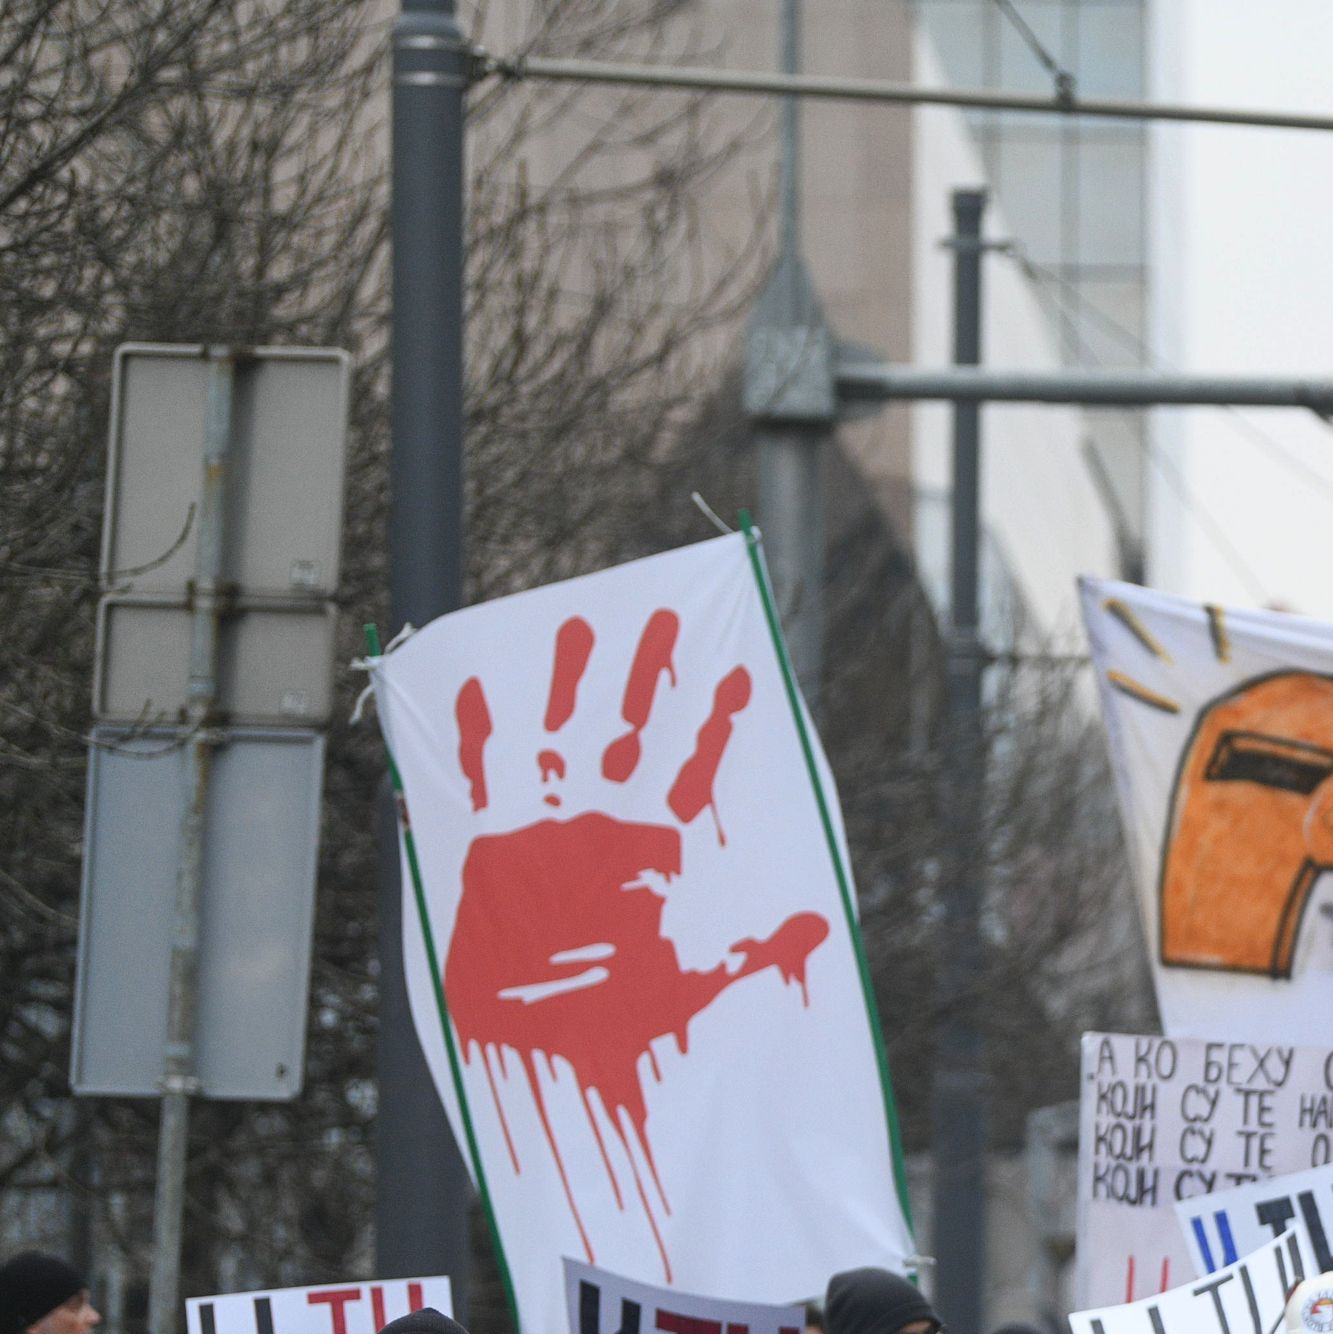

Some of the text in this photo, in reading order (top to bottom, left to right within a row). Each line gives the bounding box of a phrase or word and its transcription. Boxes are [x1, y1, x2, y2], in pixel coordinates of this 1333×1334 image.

[1135, 1040, 1178, 1081] КО
[1203, 1042, 1295, 1088] БЕХУ
[1180, 1084, 1218, 1124] СУ
[1235, 1088, 1277, 1129] ТЕ
[1179, 1128, 1215, 1166] СУ
[1236, 1131, 1277, 1170] ТЕ
